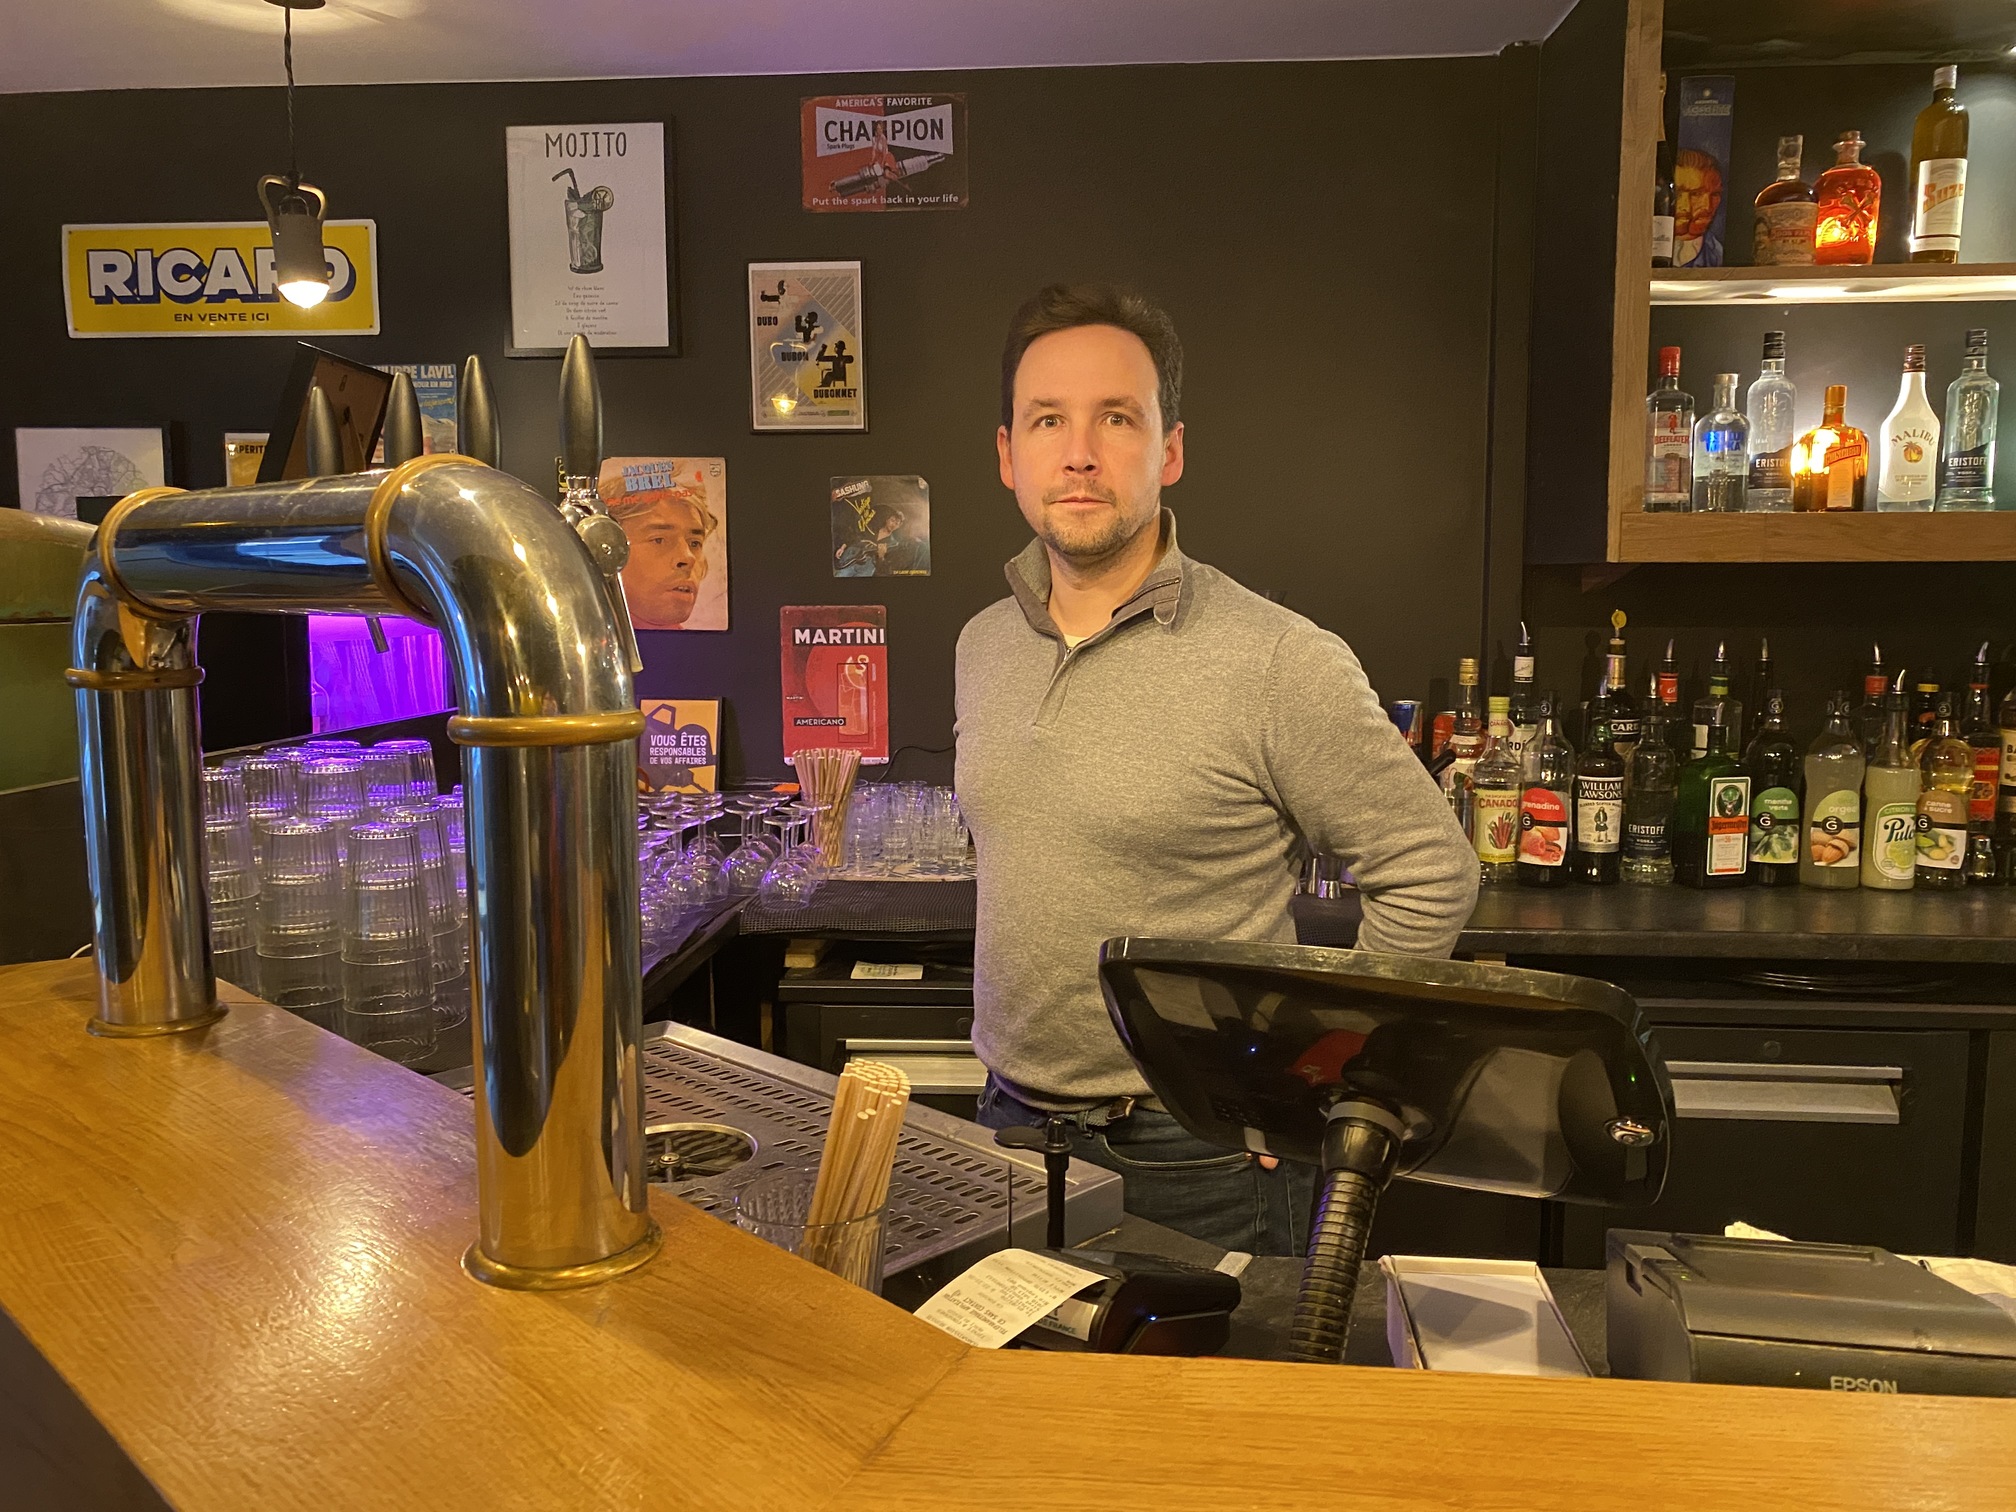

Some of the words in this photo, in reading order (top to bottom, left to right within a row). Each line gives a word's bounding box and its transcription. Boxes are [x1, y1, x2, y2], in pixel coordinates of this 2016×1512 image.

[836, 98, 883, 108] AMERICA'S
[887, 97, 933, 106] FAVORITE
[545, 132, 627, 158] MOJITO
[812, 197, 830, 206] Put
[832, 196, 850, 206] the
[851, 196, 878, 208] spark
[880, 194, 903, 205] back
[905, 194, 916, 204] in
[918, 195, 941, 206] your
[942, 193, 959, 204] life
[1923, 182, 1965, 214] Suze
[87, 248, 357, 305] RICAD
[174, 313, 194, 322] EN
[198, 312, 247, 322] VENTE
[251, 312, 270, 321] ICI
[757, 316, 779, 326] DUBO
[781, 352, 809, 361] DUBON
[813, 388, 857, 398] DUBONNET
[1654, 435, 1689, 444] BEEFEATER
[1892, 428, 1935, 447] MALIBU
[1706, 440, 1741, 451] VOKA
[622, 461, 675, 476] JACQUES
[625, 474, 677, 492] BREL
[795, 628, 885, 644] MARTINI
[796, 718, 845, 726] AMERICANO
[650, 735, 677, 747] VOUS
[680, 731, 707, 747] ÊTES
[650, 747, 707, 757] RESPONSABLES
[650, 757, 658, 765] DE
[660, 757, 673, 765] VOS
[674, 757, 707, 765] AFFAIRES
[1581, 781, 1622, 792] WILLIAM
[1628, 824, 1665, 835] ERISTOFF
[1830, 1376, 1898, 1393] EPSON
